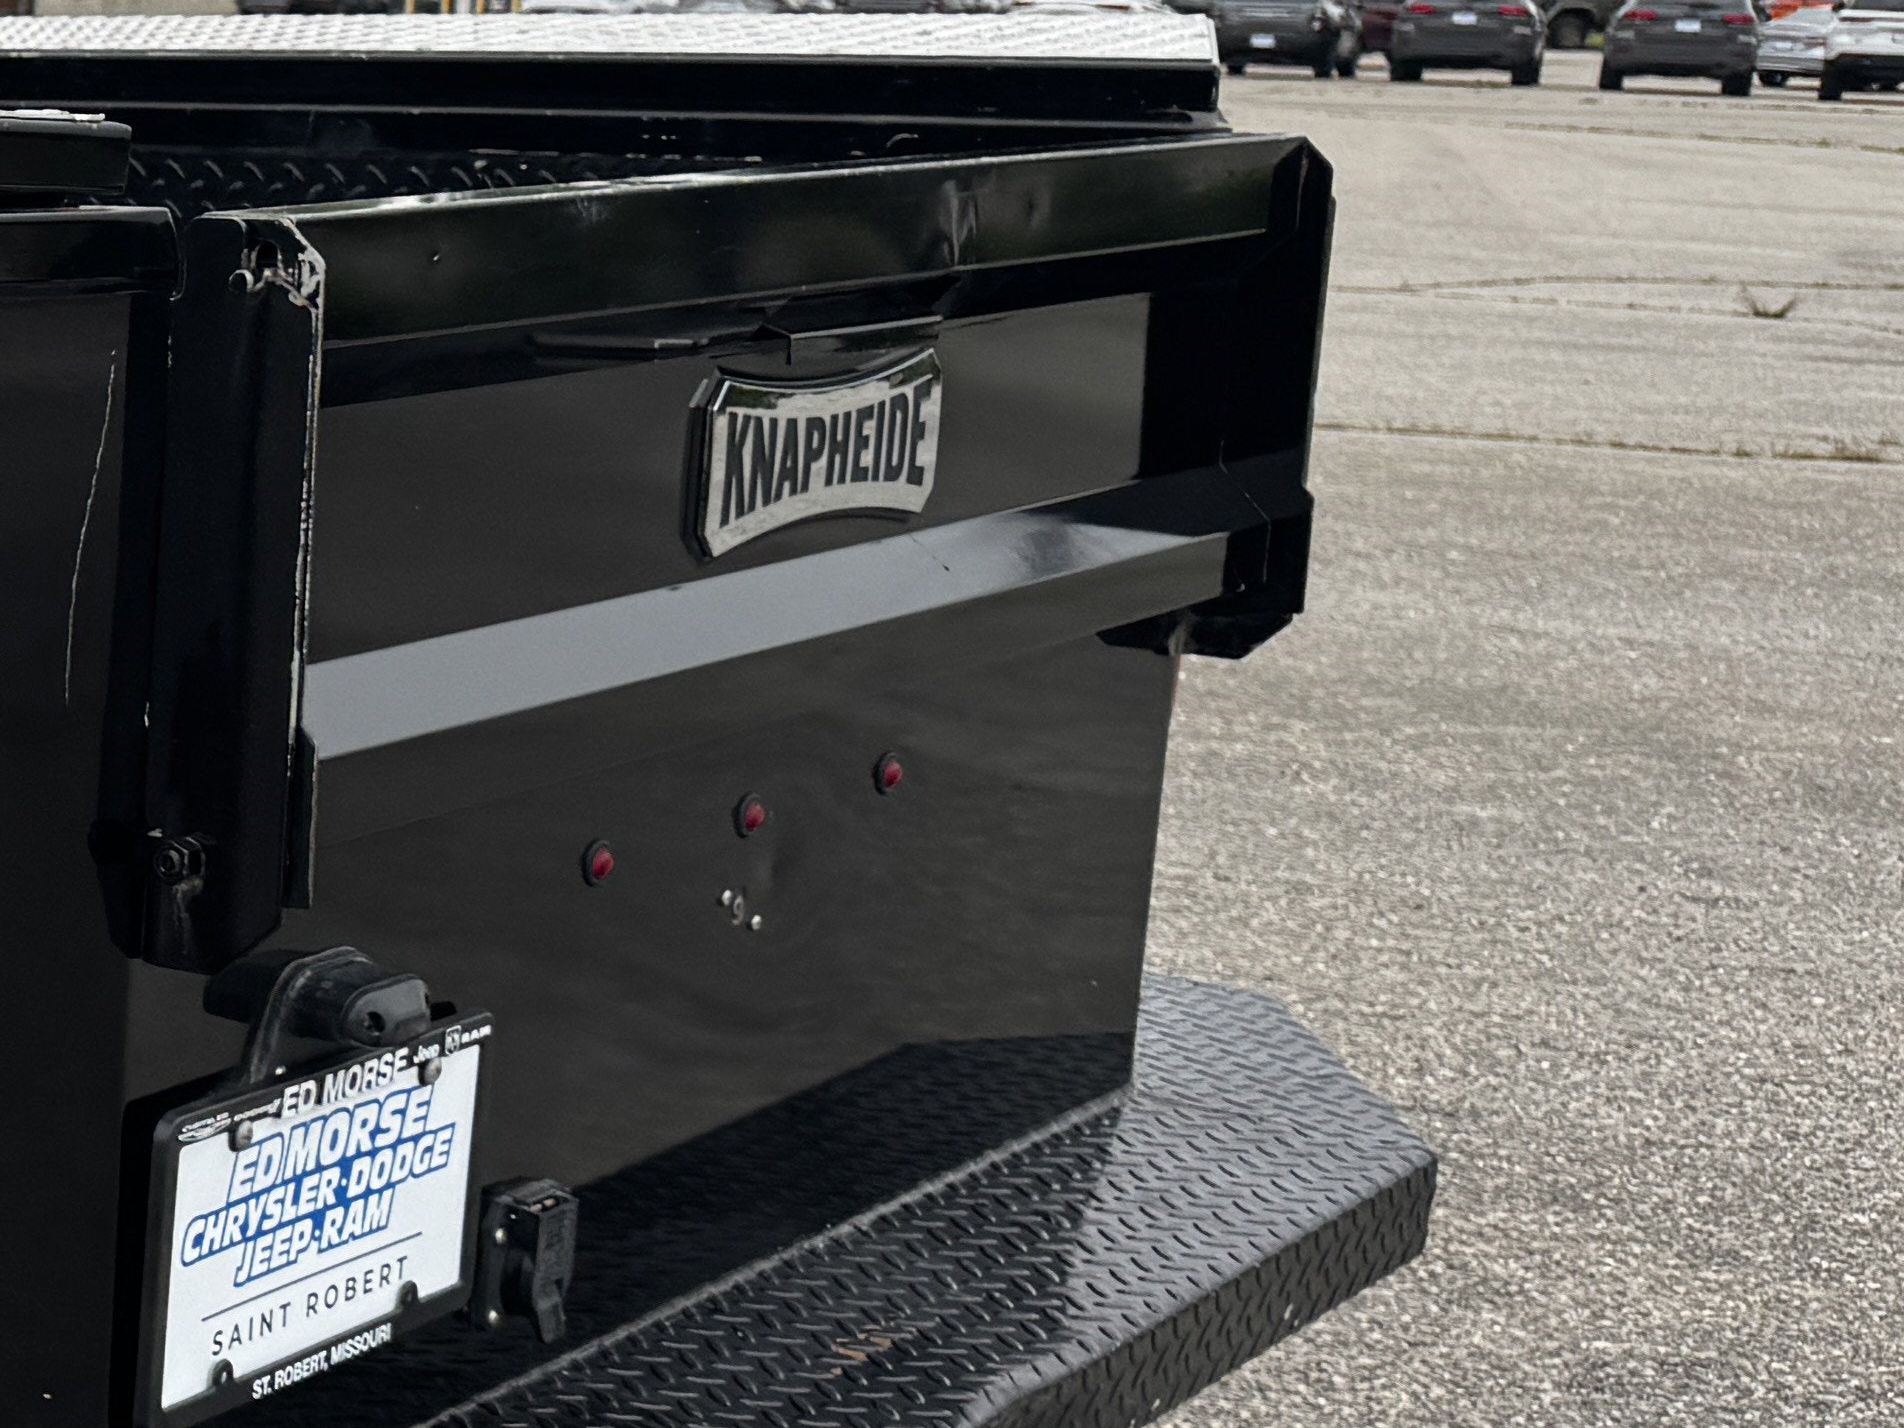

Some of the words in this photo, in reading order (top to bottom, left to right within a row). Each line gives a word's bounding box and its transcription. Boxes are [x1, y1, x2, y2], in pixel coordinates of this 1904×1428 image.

[719, 374, 934, 529] KNAPHEIDE
[281, 1079, 318, 1118] ED
[322, 1047, 409, 1105] MORSE
[227, 1133, 284, 1203] ED
[281, 1085, 432, 1182] MORSE
[211, 1302, 291, 1356] SAINT
[305, 1256, 408, 1318] ROBERT
[252, 1377, 272, 1400] ST.
[274, 1350, 328, 1391] ROBERT,
[330, 1322, 392, 1366] MISSOURI
